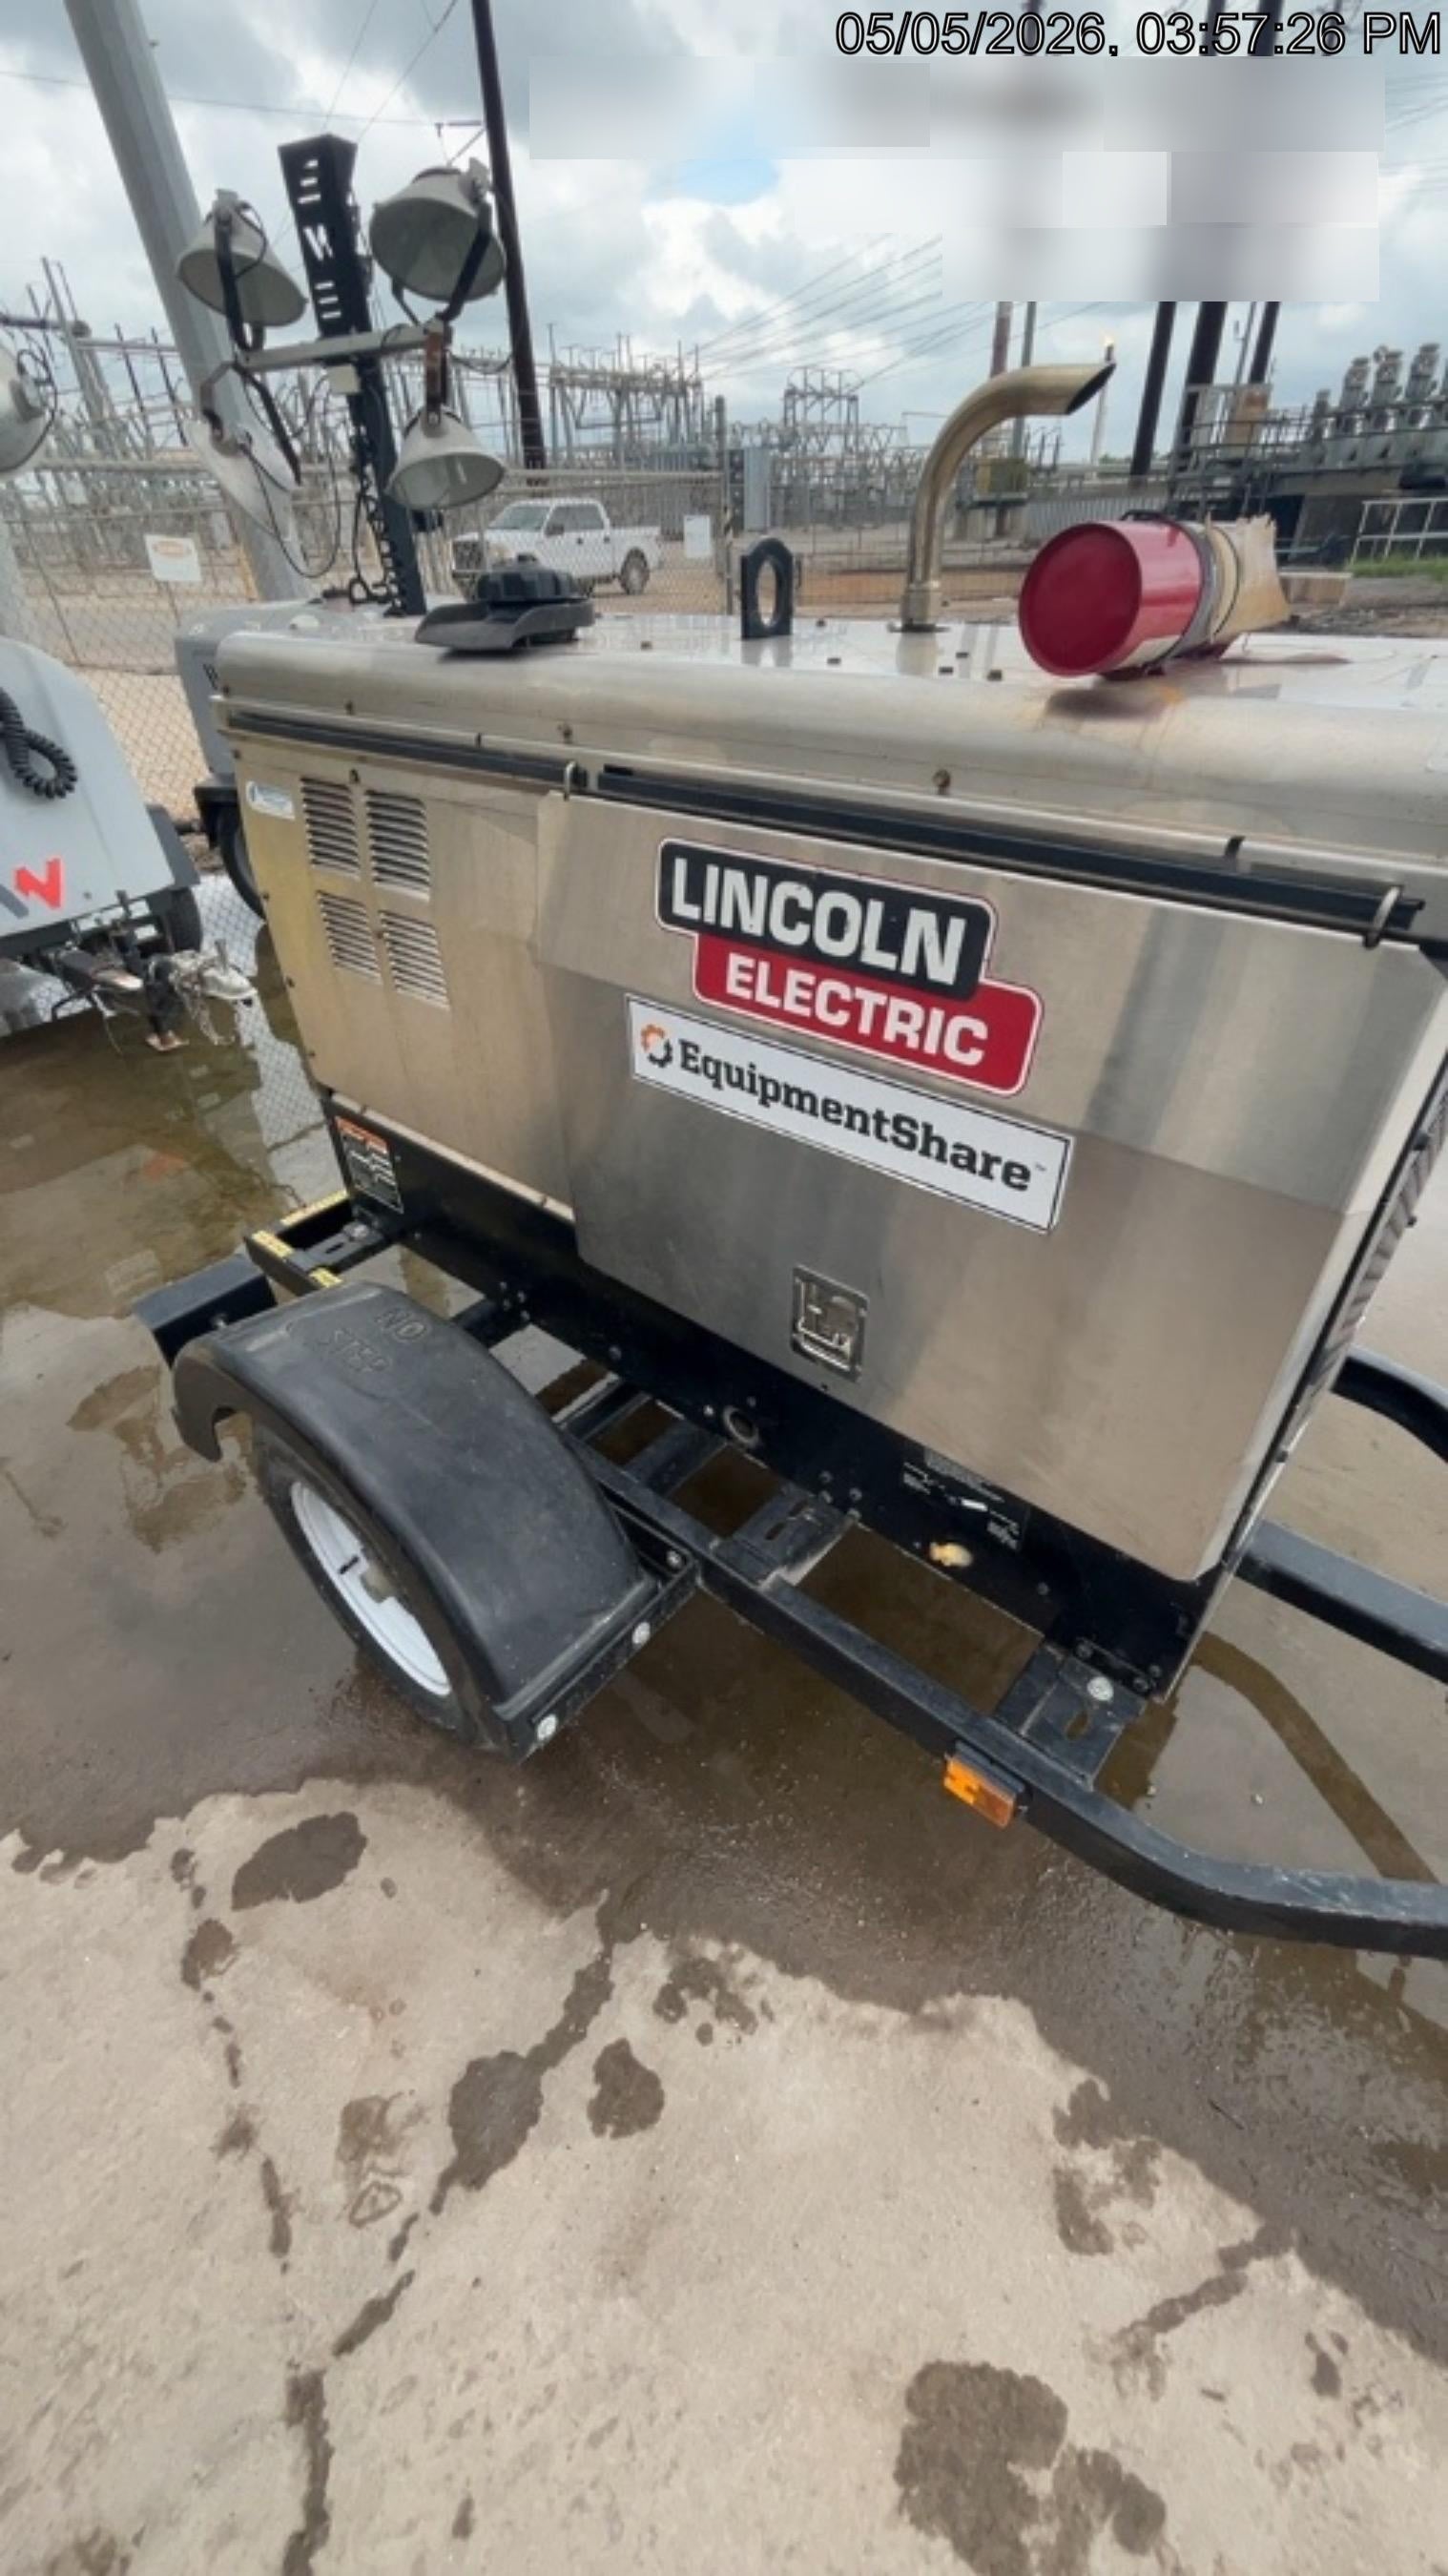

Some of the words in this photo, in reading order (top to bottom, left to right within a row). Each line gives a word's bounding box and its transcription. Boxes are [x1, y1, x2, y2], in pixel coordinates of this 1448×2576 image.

[671, 857, 967, 986] LINCOLN
[724, 951, 989, 1068] ELECTRIC
[678, 1038, 1032, 1193] EquipmentShare
[319, 1325, 393, 1374] STEP
[376, 1306, 429, 1344] NO
